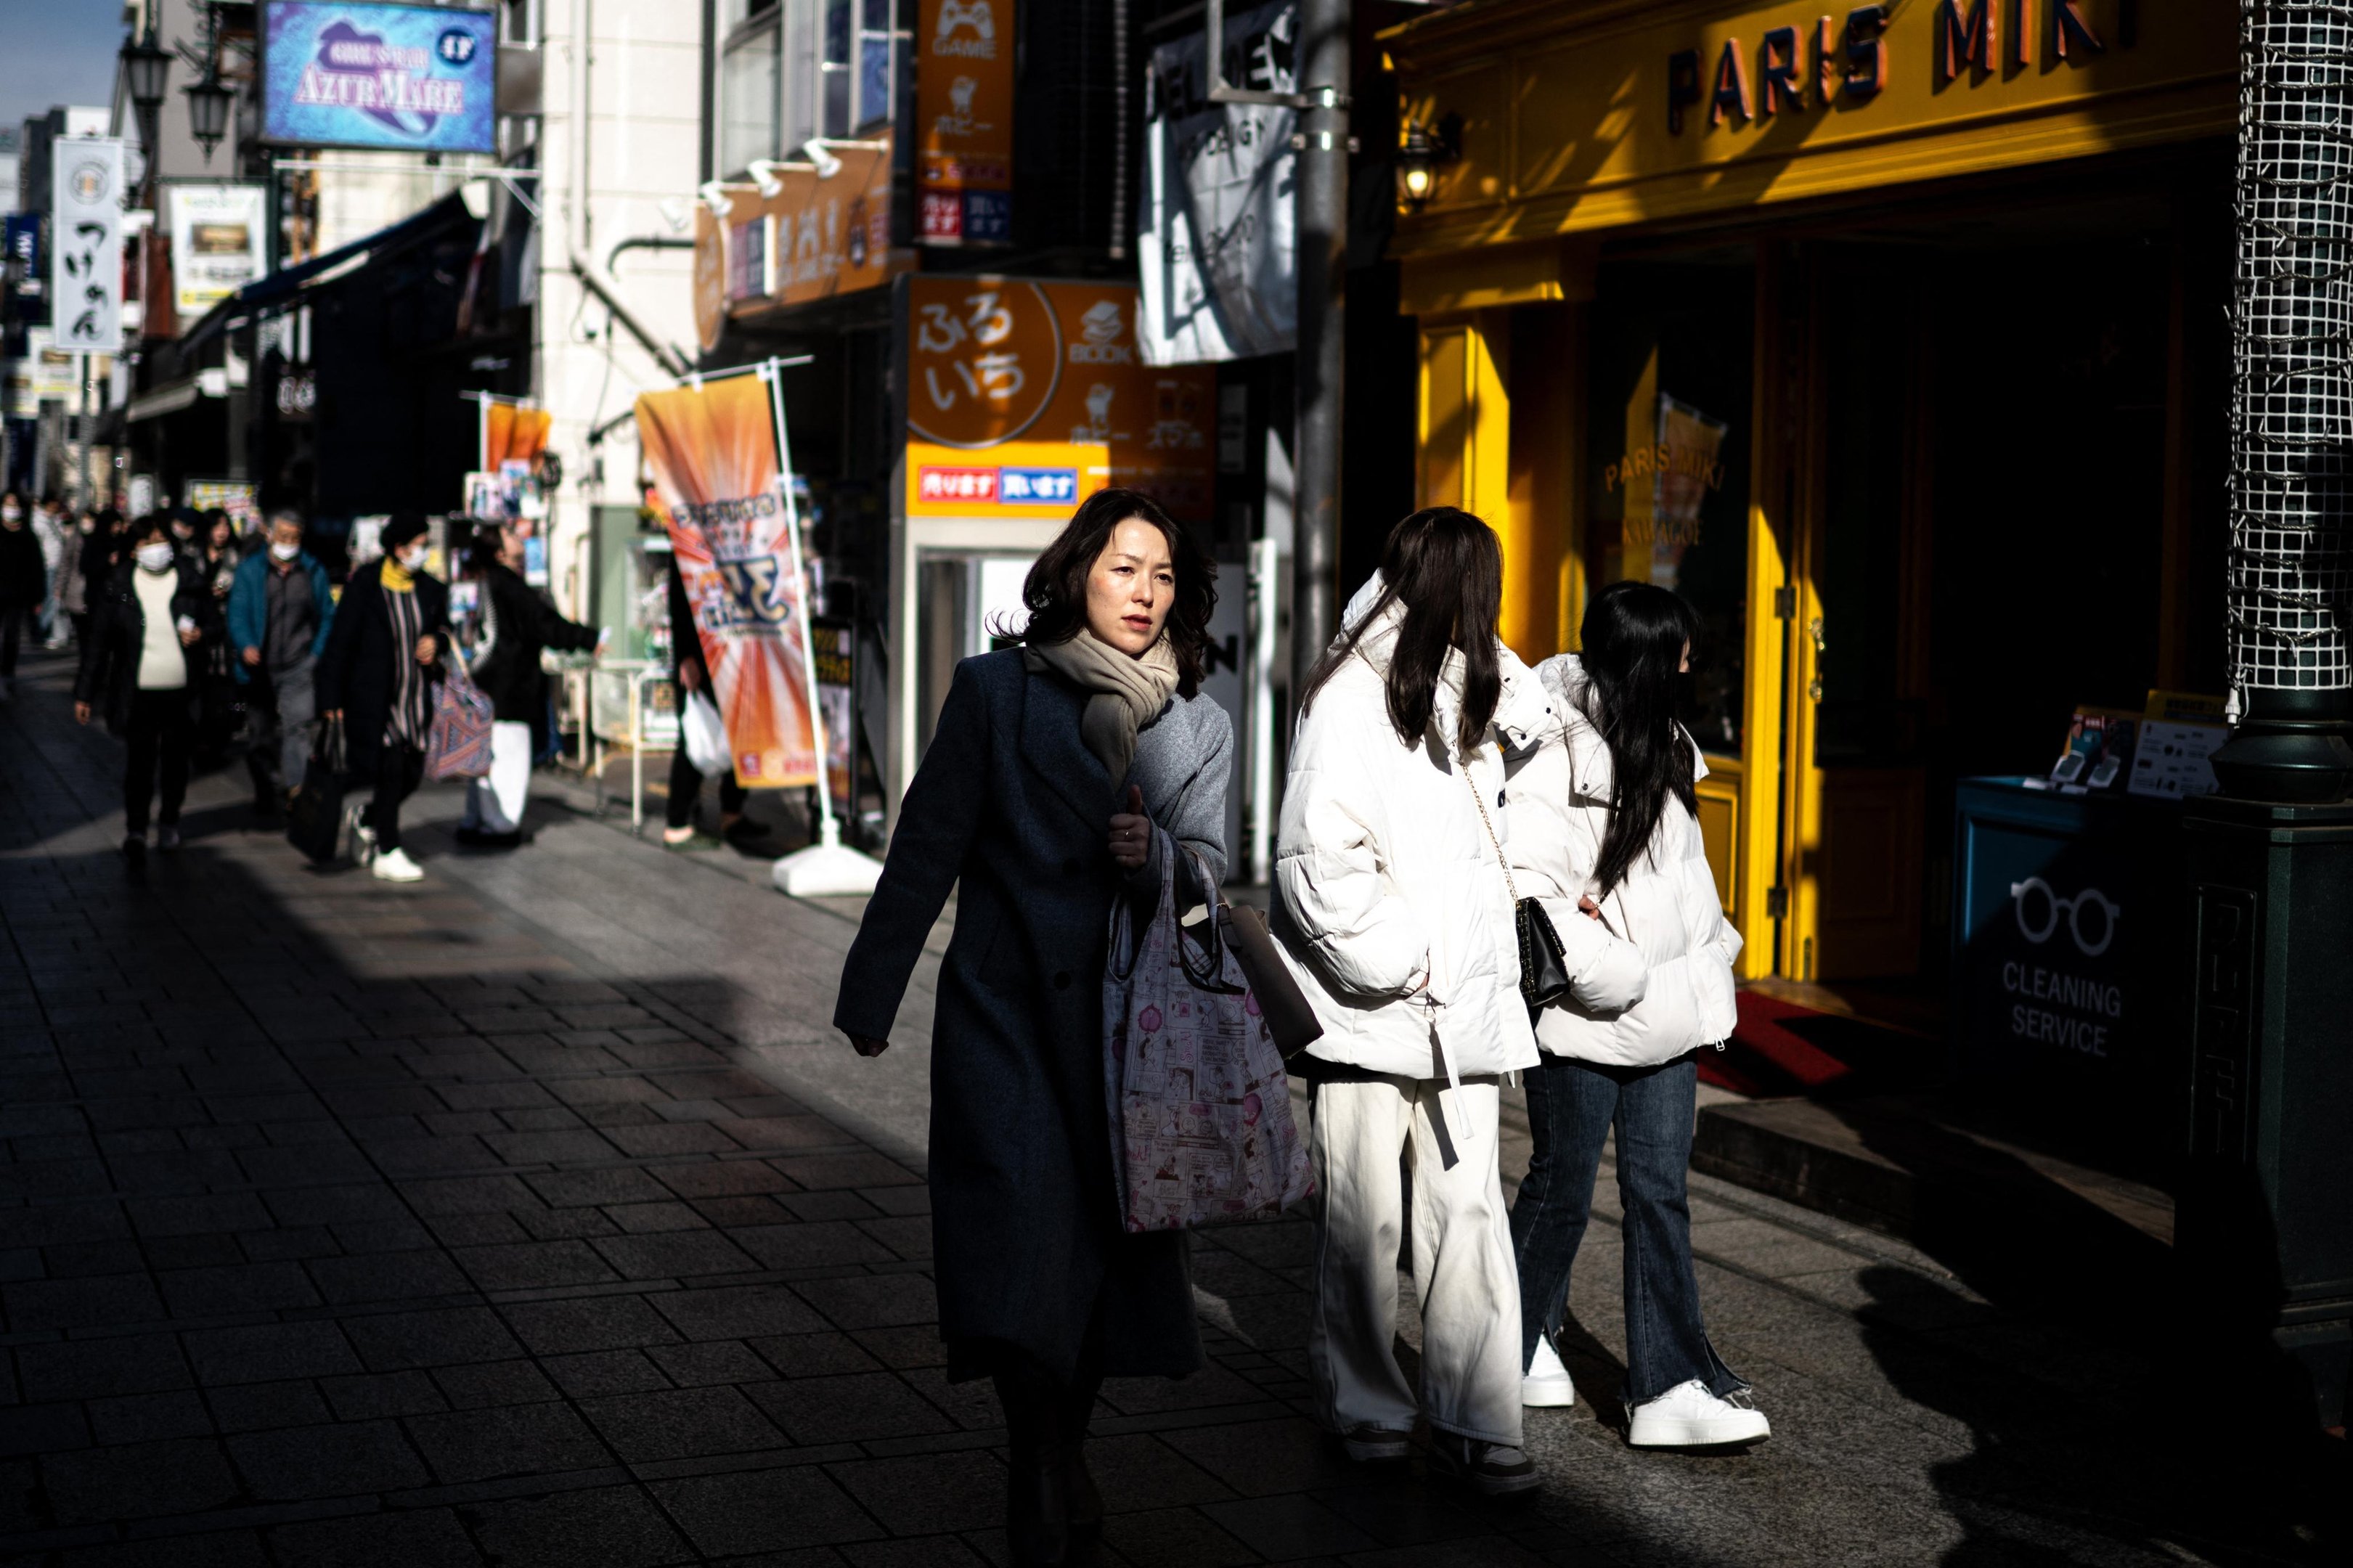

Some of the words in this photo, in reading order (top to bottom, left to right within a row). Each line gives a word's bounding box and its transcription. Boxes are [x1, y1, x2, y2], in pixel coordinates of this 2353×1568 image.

[932, 38, 997, 60] GAME
[1669, 3, 1886, 134] PARIS
[1942, 0, 2137, 81] MIKI
[65, 219, 108, 340] つけめん
[917, 292, 1014, 354] ふる
[1069, 343, 1133, 364] BOOK
[925, 351, 1026, 412] いち
[923, 473, 992, 497] 売ります
[1003, 474, 1072, 499] 買います
[1604, 444, 1670, 494] PARIS
[1677, 445, 1726, 492] MIKI
[2002, 960, 2122, 1019] CLEANING
[2011, 1003, 2109, 1058] SERVICE
